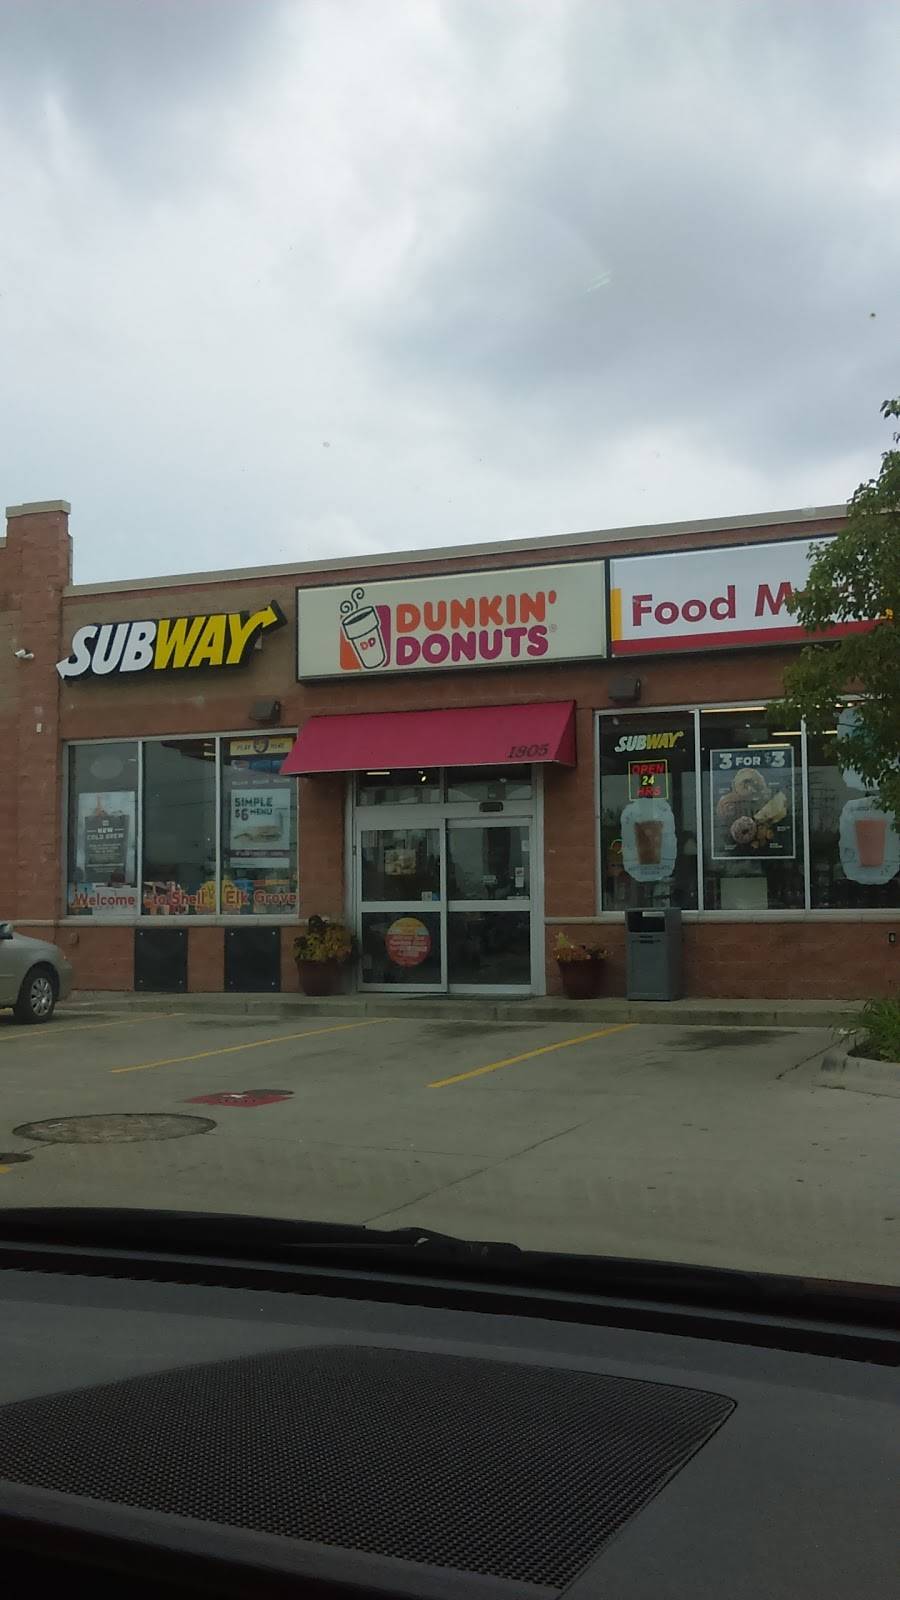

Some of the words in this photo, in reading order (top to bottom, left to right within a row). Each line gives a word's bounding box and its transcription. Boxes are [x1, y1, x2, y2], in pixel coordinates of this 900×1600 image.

[396, 590, 557, 633] DUNKIN'
[632, 585, 736, 627] Food
[56, 605, 278, 680] SUBWAY
[360, 637, 376, 651] DD
[396, 625, 549, 666] DONUTS
[614, 731, 684, 753] SUBWAY
[507, 743, 549, 759] 1805
[632, 762, 664, 775] OPEN
[719, 753, 732, 769] 3
[735, 756, 761, 766] FOR
[641, 775, 655, 786] 24
[234, 797, 273, 808] SIMPLE
[76, 893, 136, 908] Welcome
[153, 894, 165, 906] to
[171, 891, 205, 906] Shell
[226, 890, 248, 905] Elk
[254, 891, 297, 906] Grove
